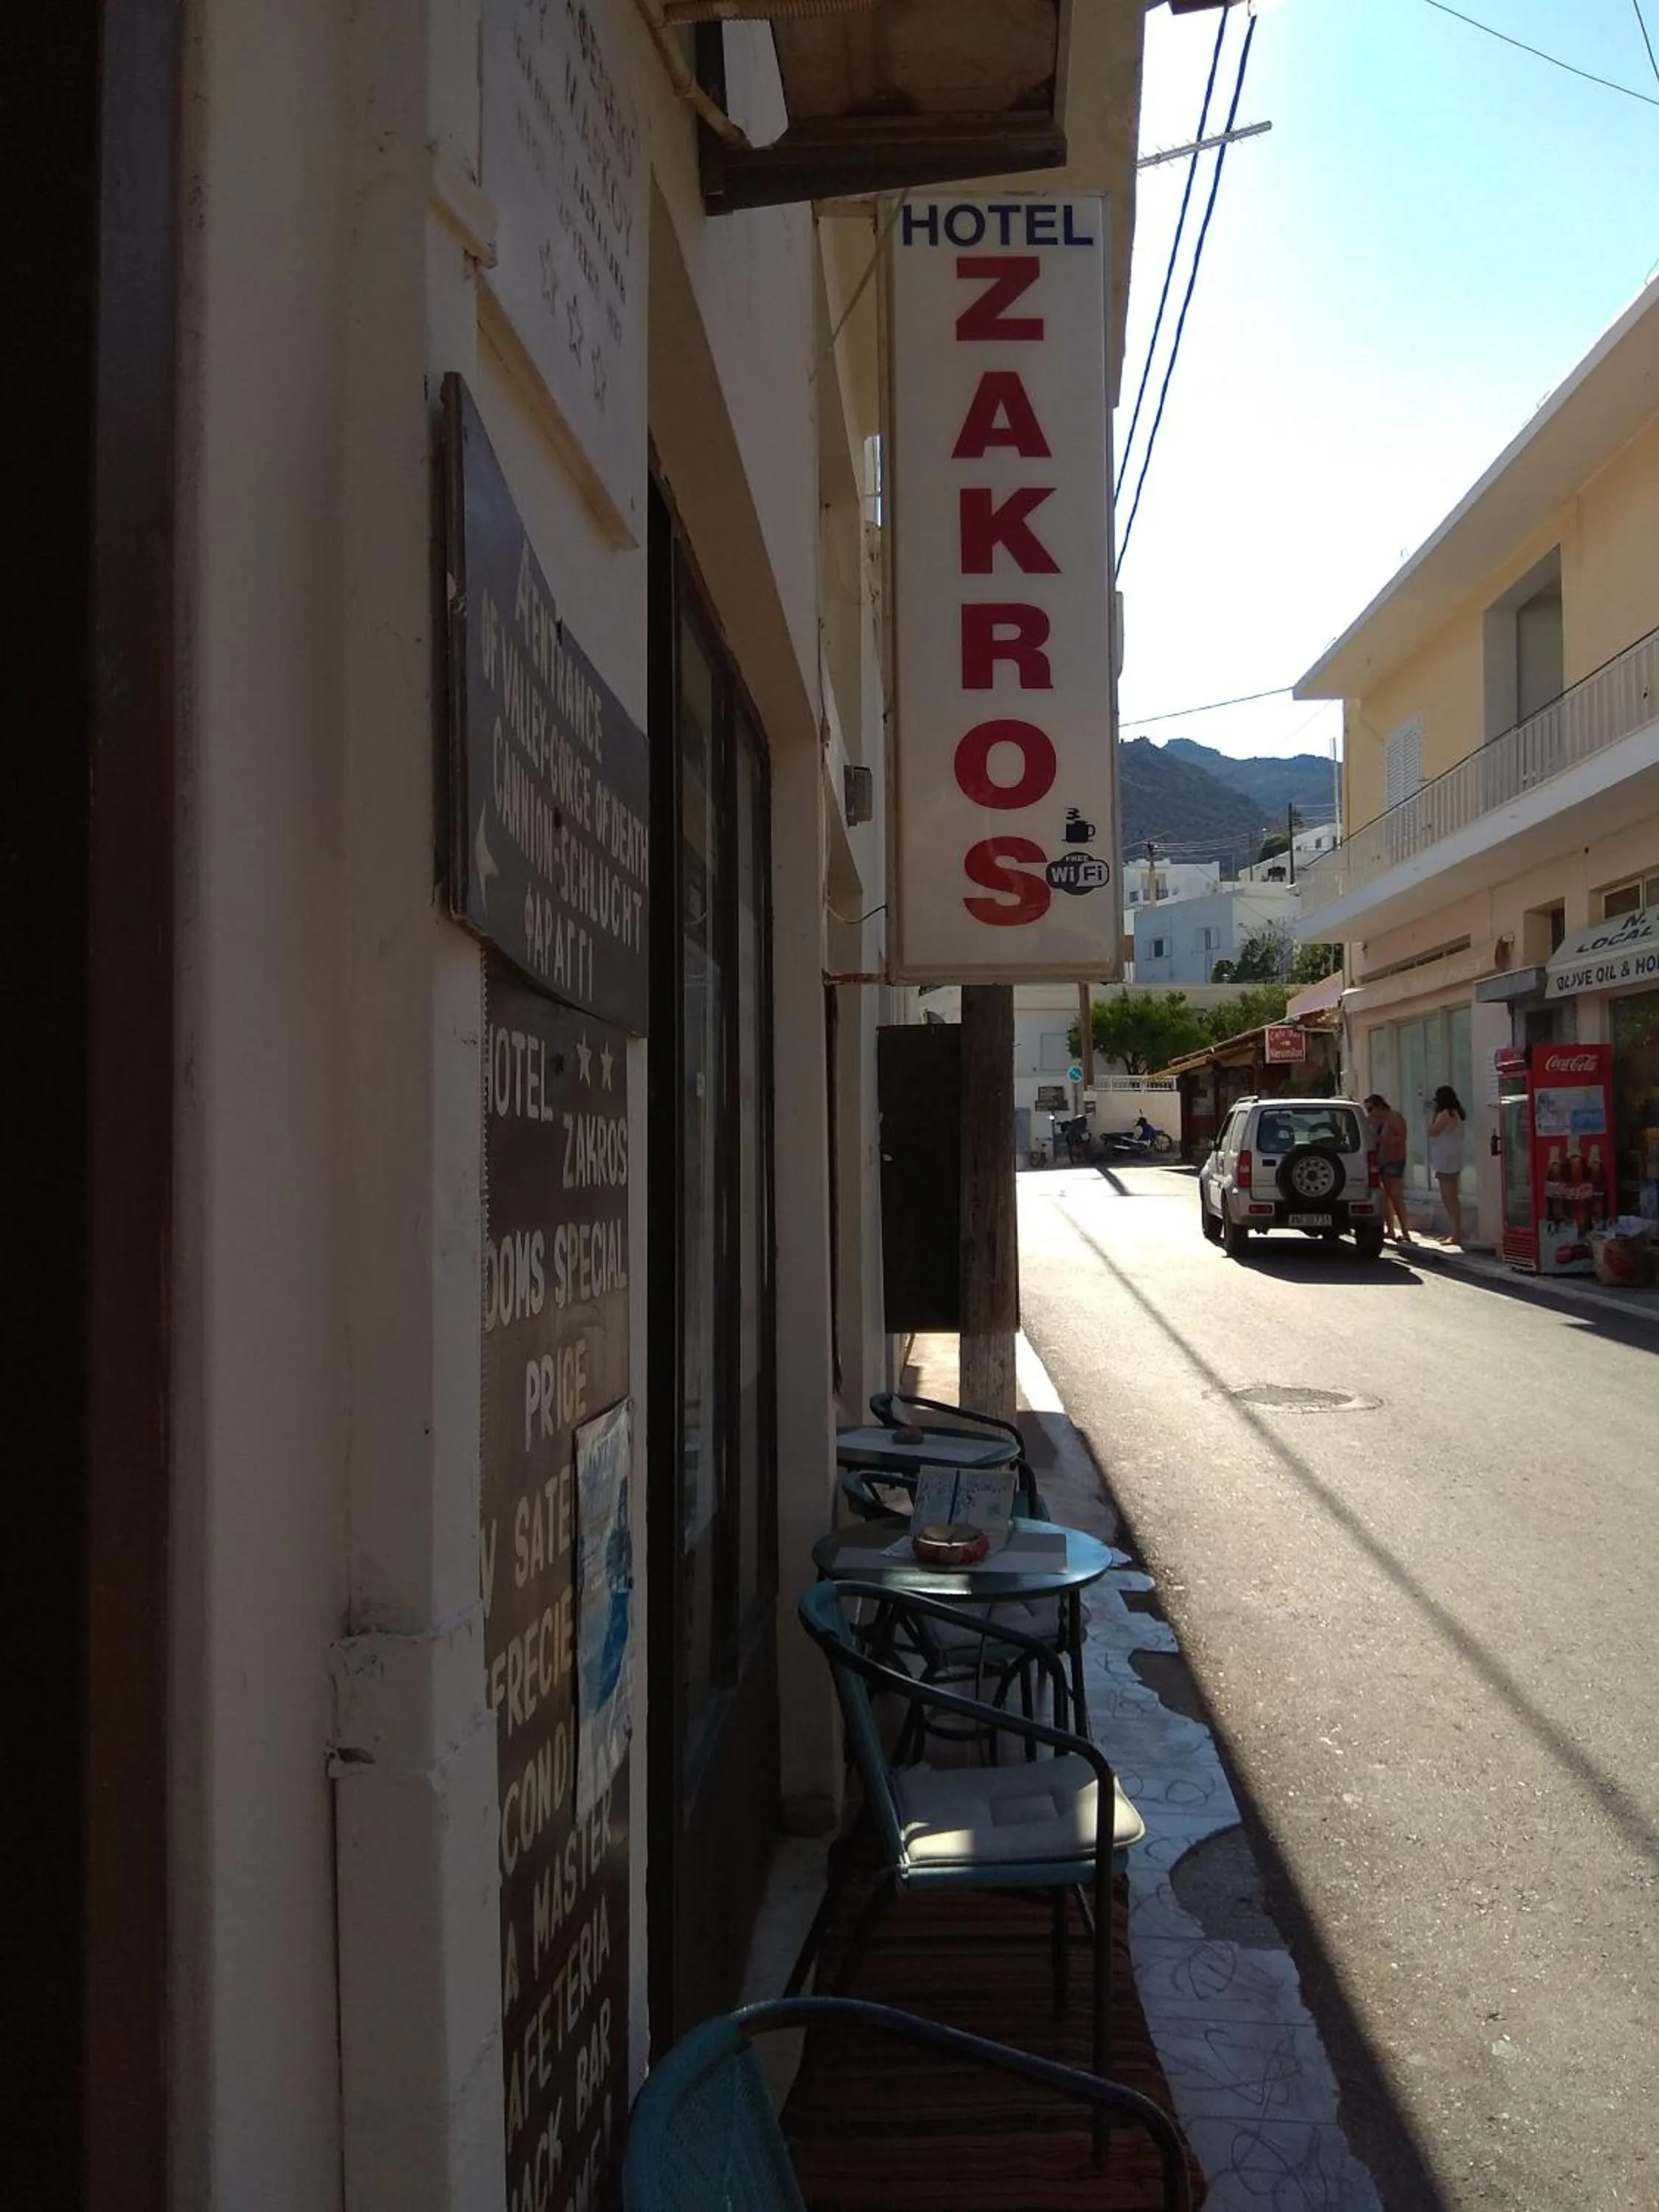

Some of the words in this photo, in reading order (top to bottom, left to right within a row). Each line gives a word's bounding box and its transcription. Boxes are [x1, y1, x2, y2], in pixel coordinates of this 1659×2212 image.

[903, 205, 1093, 246] HOTEL
[951, 257, 1061, 926] ZAKROS
[481, 588, 498, 689] OF
[596, 779, 610, 846] OF
[611, 793, 649, 886] DEATH
[533, 592, 603, 764] ENTRANCE
[1556, 970, 1593, 991] OLIVE
[1596, 964, 1617, 984] OIL
[1621, 961, 1630, 978] &
[1576, 925, 1652, 953] LOCAL
[563, 1113, 627, 1189] ZAKROS
[554, 1218, 627, 1310] SPECIAL
[525, 1338, 587, 1453] PRICE
[532, 1788, 612, 1981] MASTER
[508, 1893, 611, 2154] AFETERIA
[577, 1997, 611, 2133] BAR
